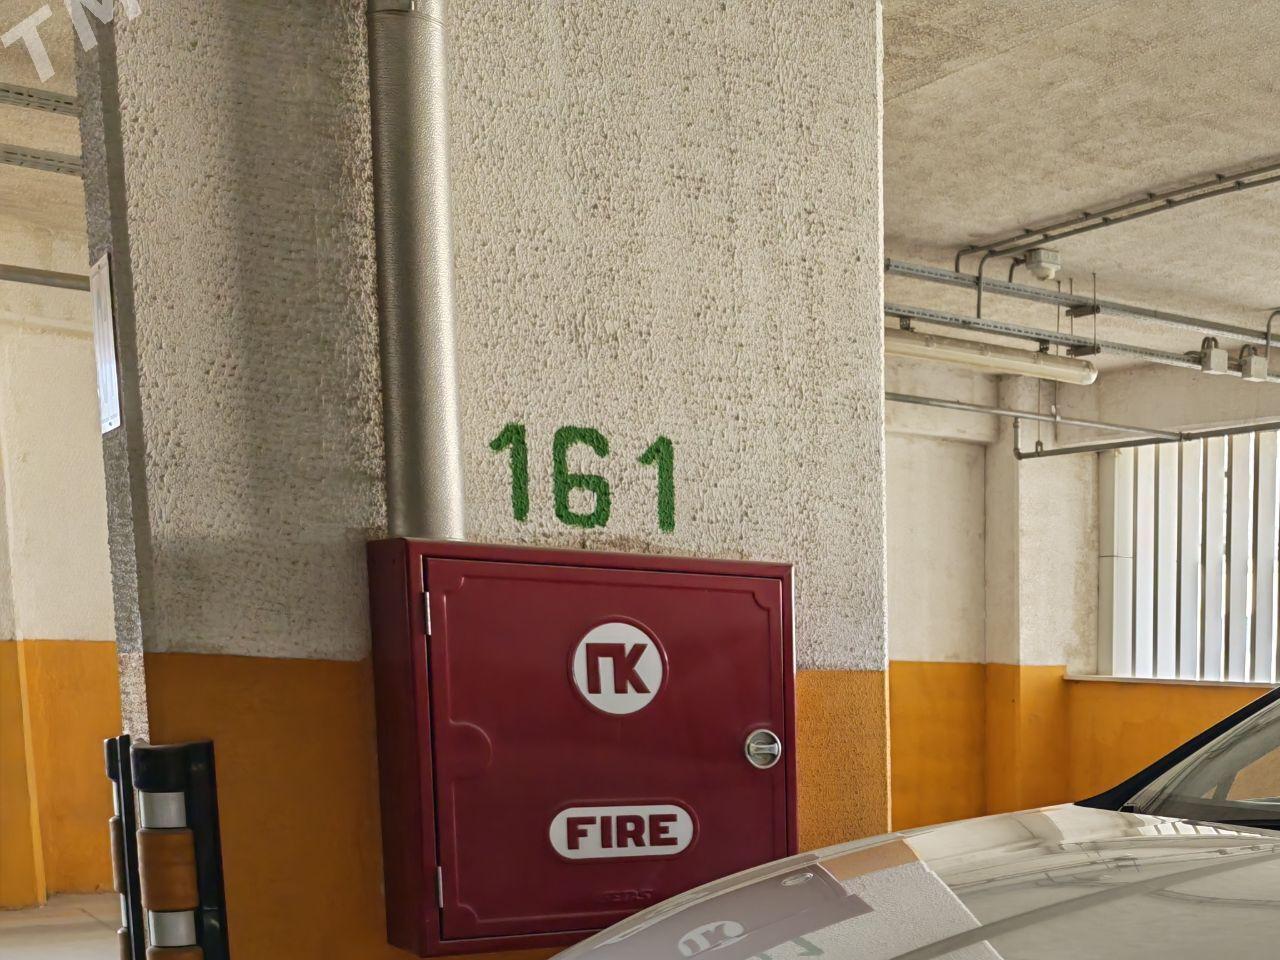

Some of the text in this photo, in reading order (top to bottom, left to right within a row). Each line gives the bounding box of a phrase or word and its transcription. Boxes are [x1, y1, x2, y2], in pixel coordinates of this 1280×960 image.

[489, 422, 675, 534] 161
[586, 643, 651, 694] ПК
[566, 814, 677, 851] FIRE
